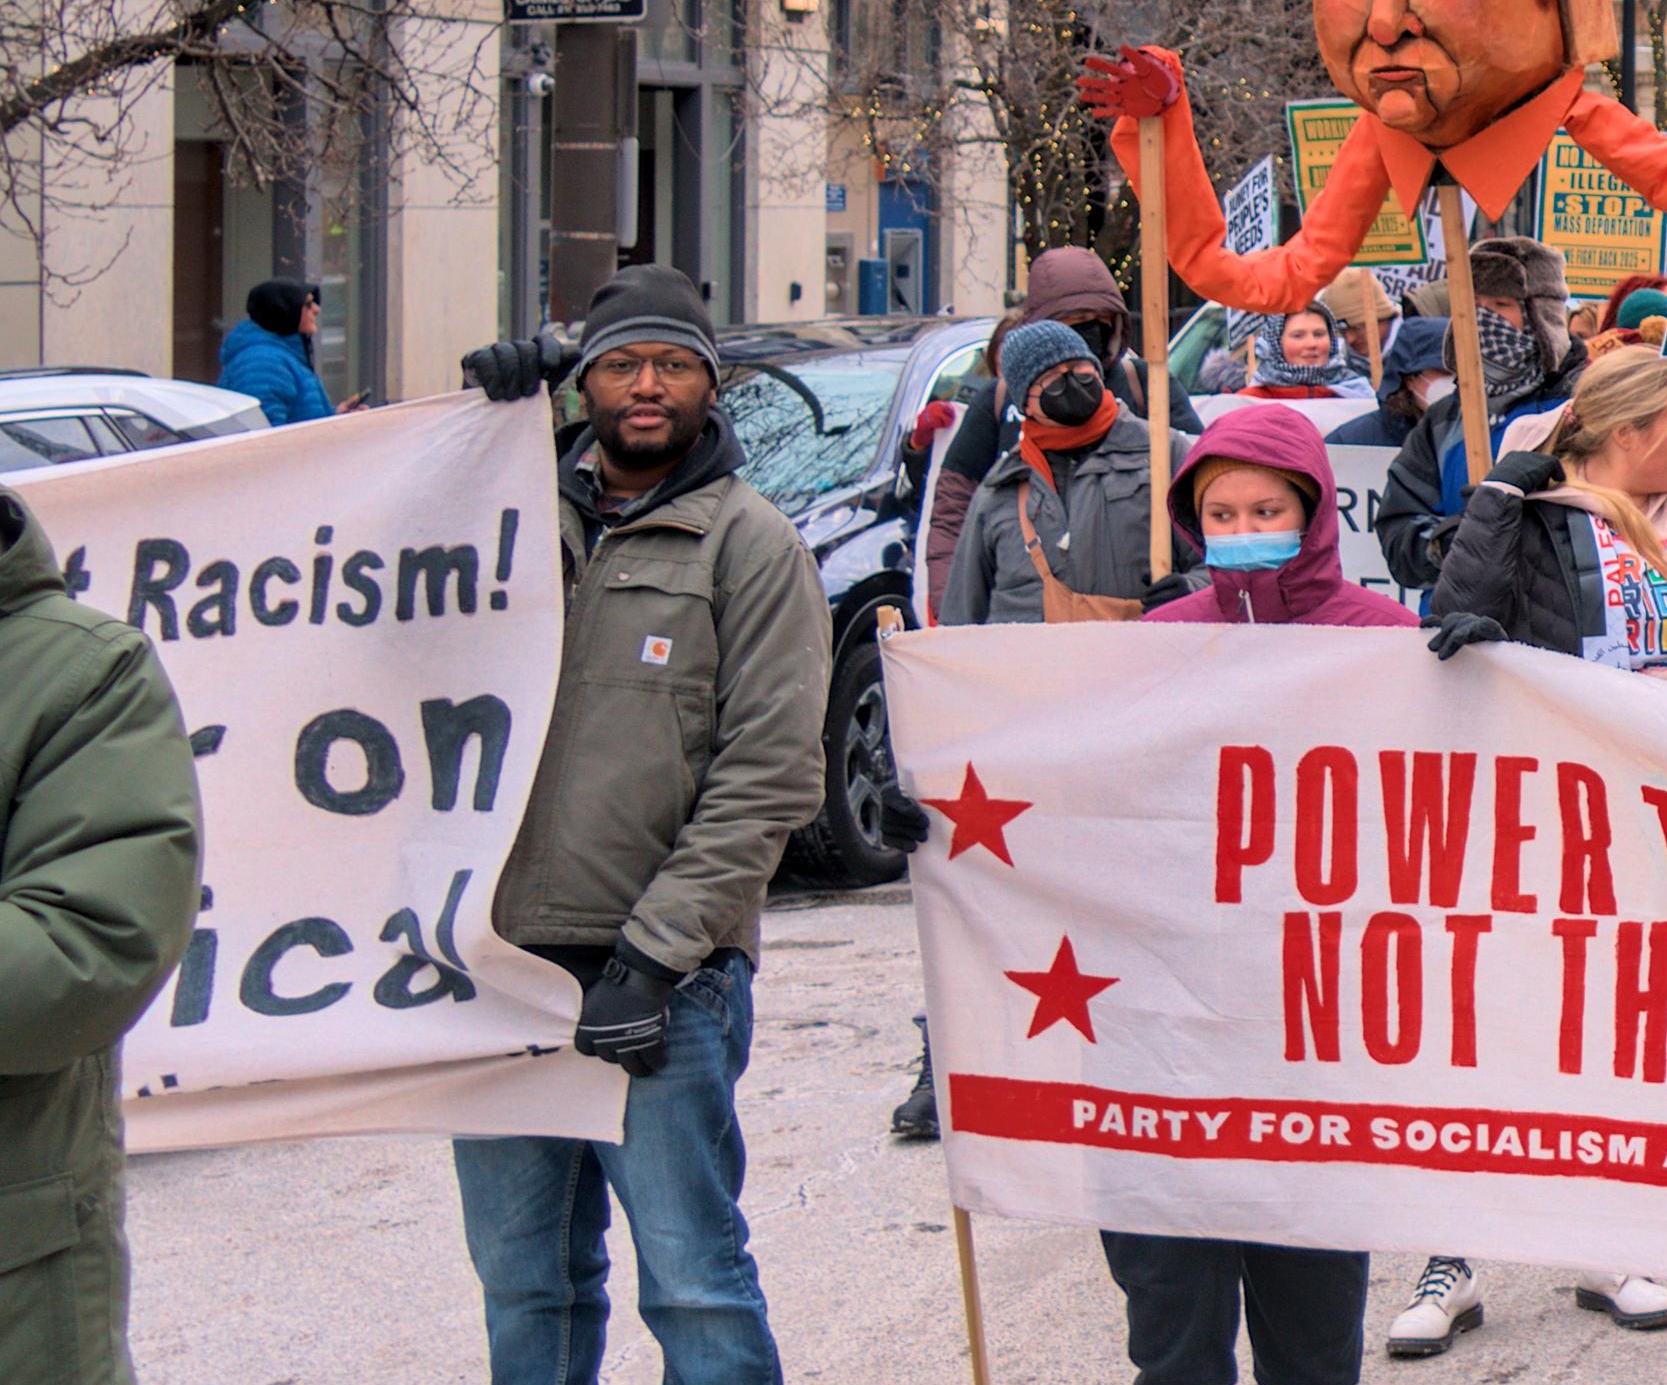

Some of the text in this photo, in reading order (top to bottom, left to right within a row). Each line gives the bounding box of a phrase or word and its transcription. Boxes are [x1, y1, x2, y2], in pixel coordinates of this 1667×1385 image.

[1559, 146, 1579, 168] NO
[1570, 172, 1633, 192] ILLEGA
[1554, 217, 1651, 237] MASS DEPORTATION
[1565, 196, 1644, 216] STOP
[128, 507, 521, 642] Racism!
[294, 693, 513, 815] on
[1214, 745, 1618, 916] POWER
[1282, 911, 1493, 1069] NOT
[1072, 1100, 1231, 1142] PARTY
[1249, 1110, 1352, 1147] FOR
[1370, 1116, 1650, 1166] SOCIALISM
